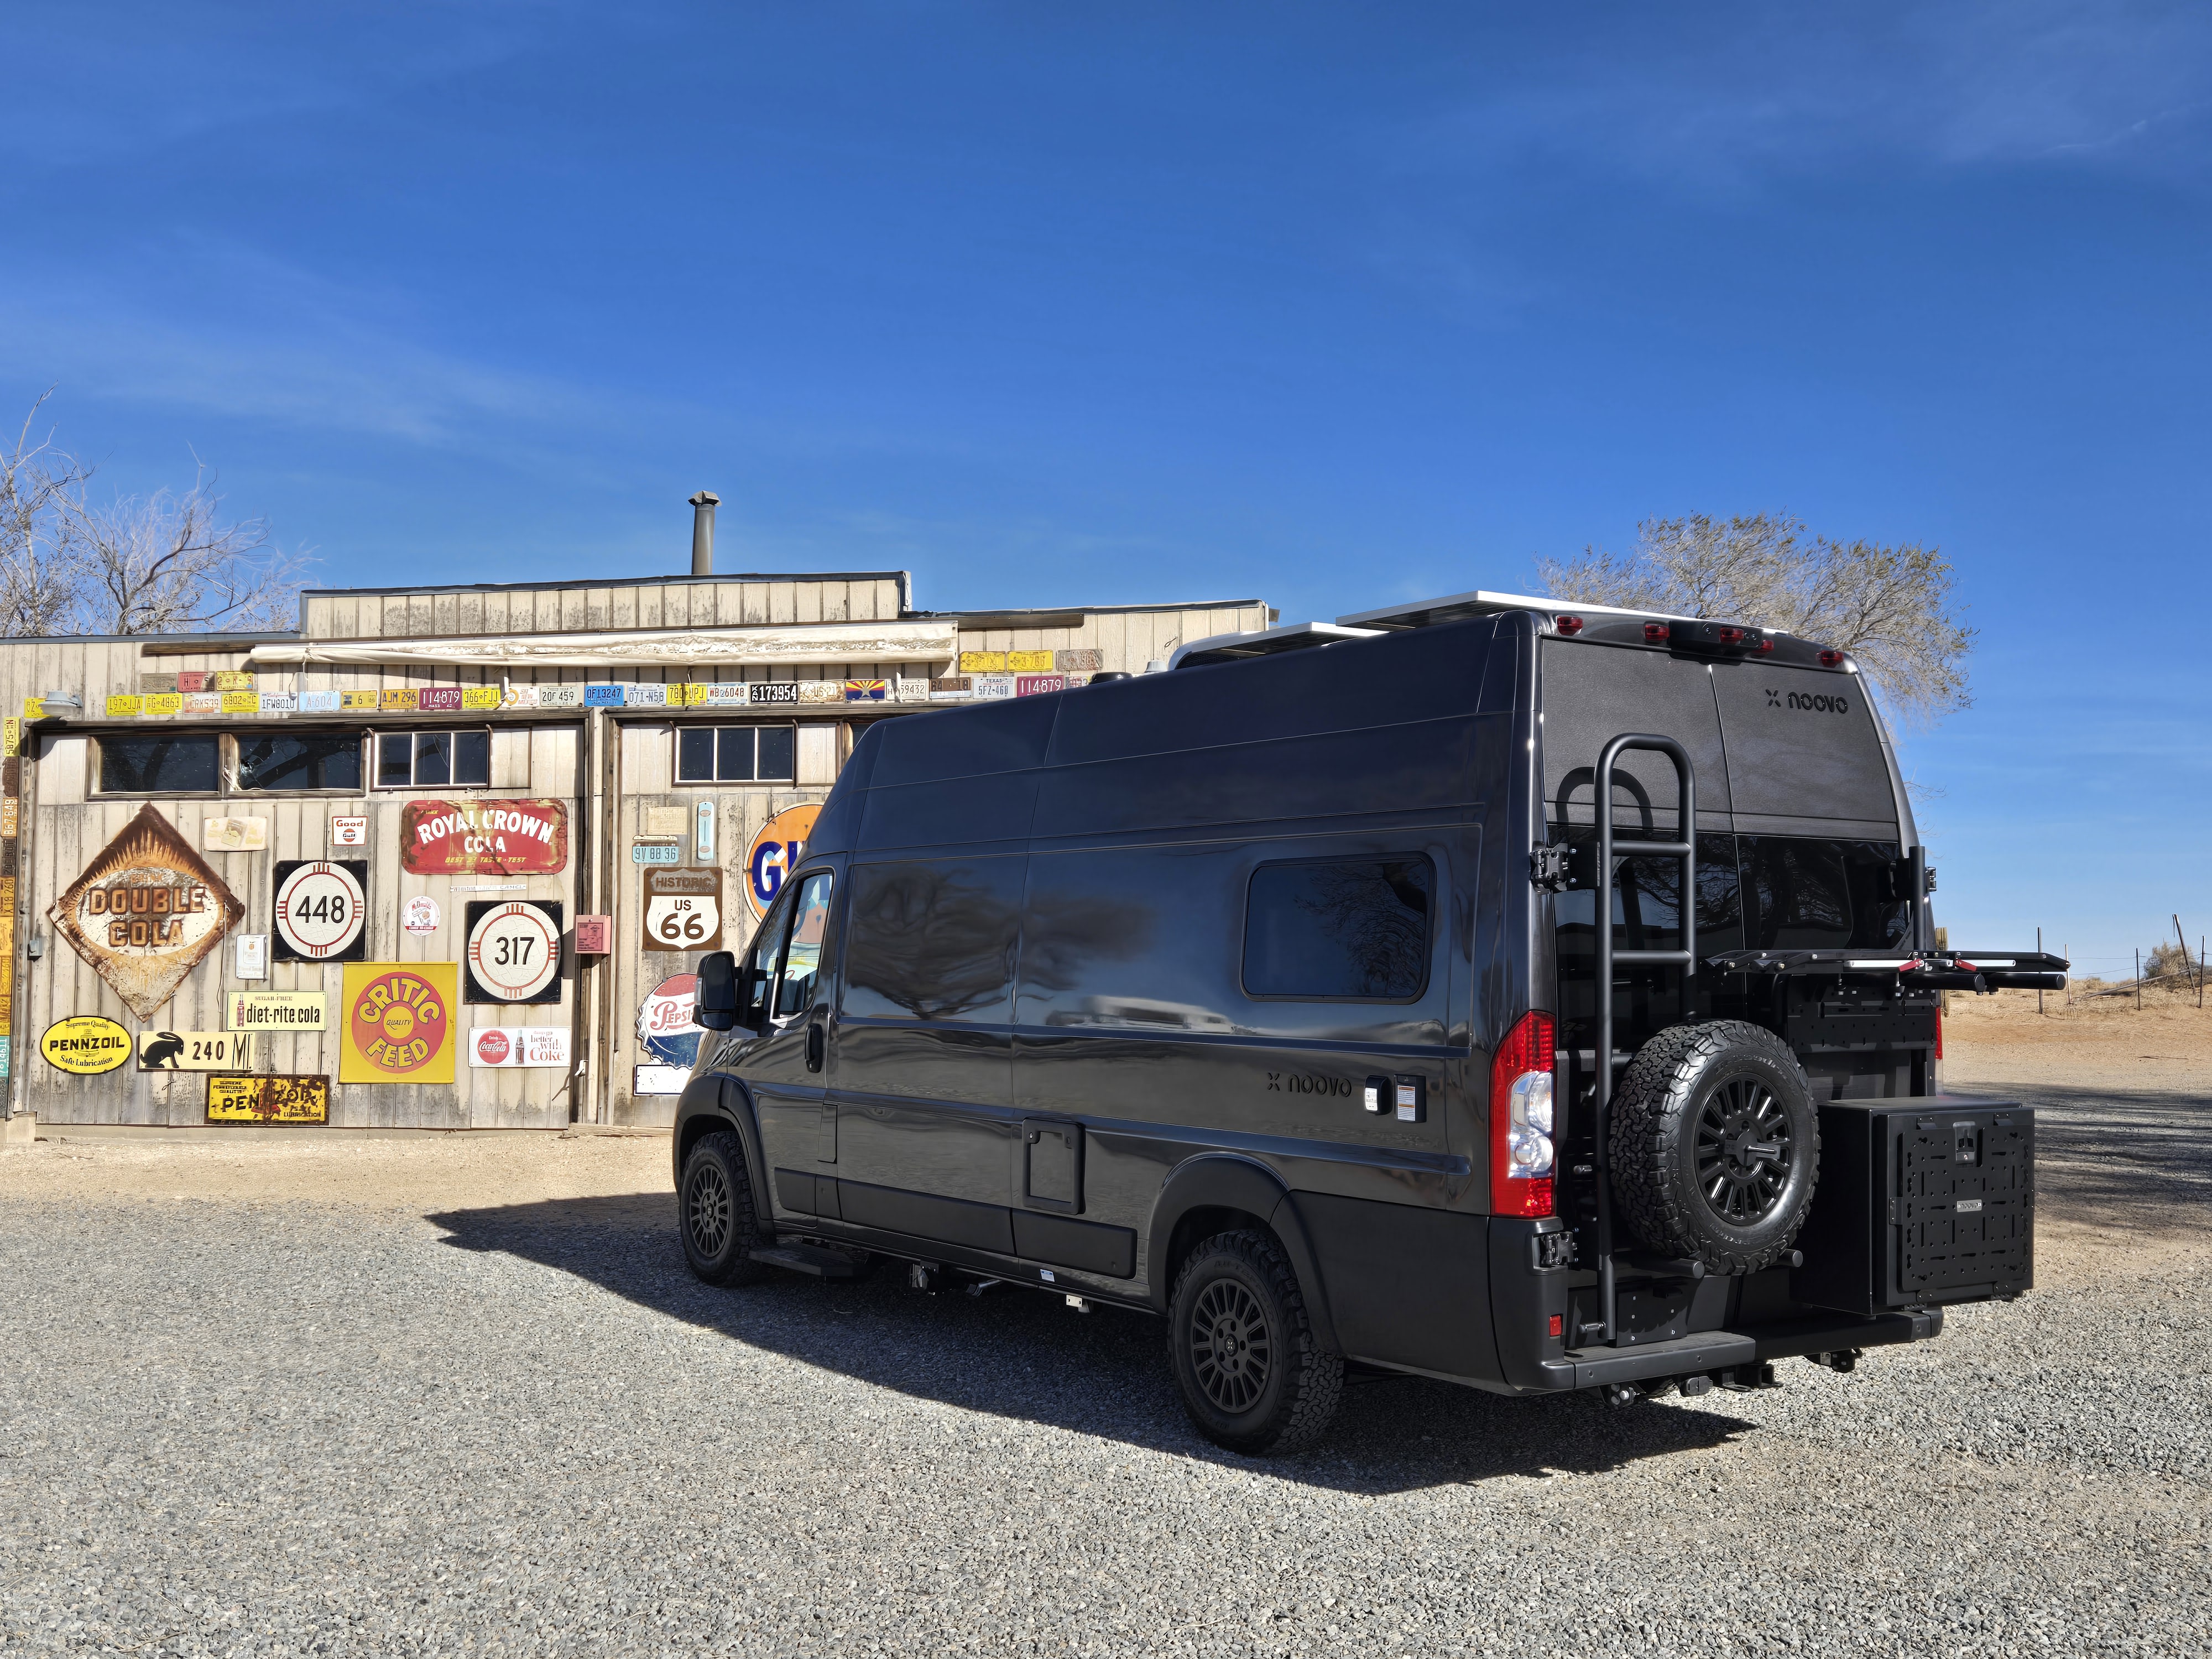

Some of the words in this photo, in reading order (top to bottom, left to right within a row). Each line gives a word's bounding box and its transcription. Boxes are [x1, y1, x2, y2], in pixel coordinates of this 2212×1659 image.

[759, 685, 797, 701] 173954
[1787, 691, 1848, 714] noovo
[417, 810, 478, 845] ROYAL
[482, 809, 555, 844] CROWN
[464, 835, 507, 853] COLA
[655, 877, 713, 888] HISTORIC
[88, 886, 207, 915] DOUBLE
[295, 895, 345, 924] 448
[674, 899, 692, 911] US
[108, 919, 187, 947] COLA
[660, 912, 705, 940] 66
[494, 936, 535, 966] 317
[358, 977, 441, 1025] CRITIC
[247, 1003, 295, 1023] diet-rite
[298, 1005, 320, 1023] cola
[386, 1019, 412, 1030] QUALITY
[49, 1036, 125, 1052] PENNZOIL
[192, 1040, 225, 1061] 240
[365, 1036, 429, 1068] FEED
[529, 1047, 565, 1061] Coke
[540, 1039, 562, 1050] with
[60, 1055, 75, 1065] Safe
[76, 1056, 113, 1067] Lubrication
[1288, 1074, 1352, 1098] noovo
